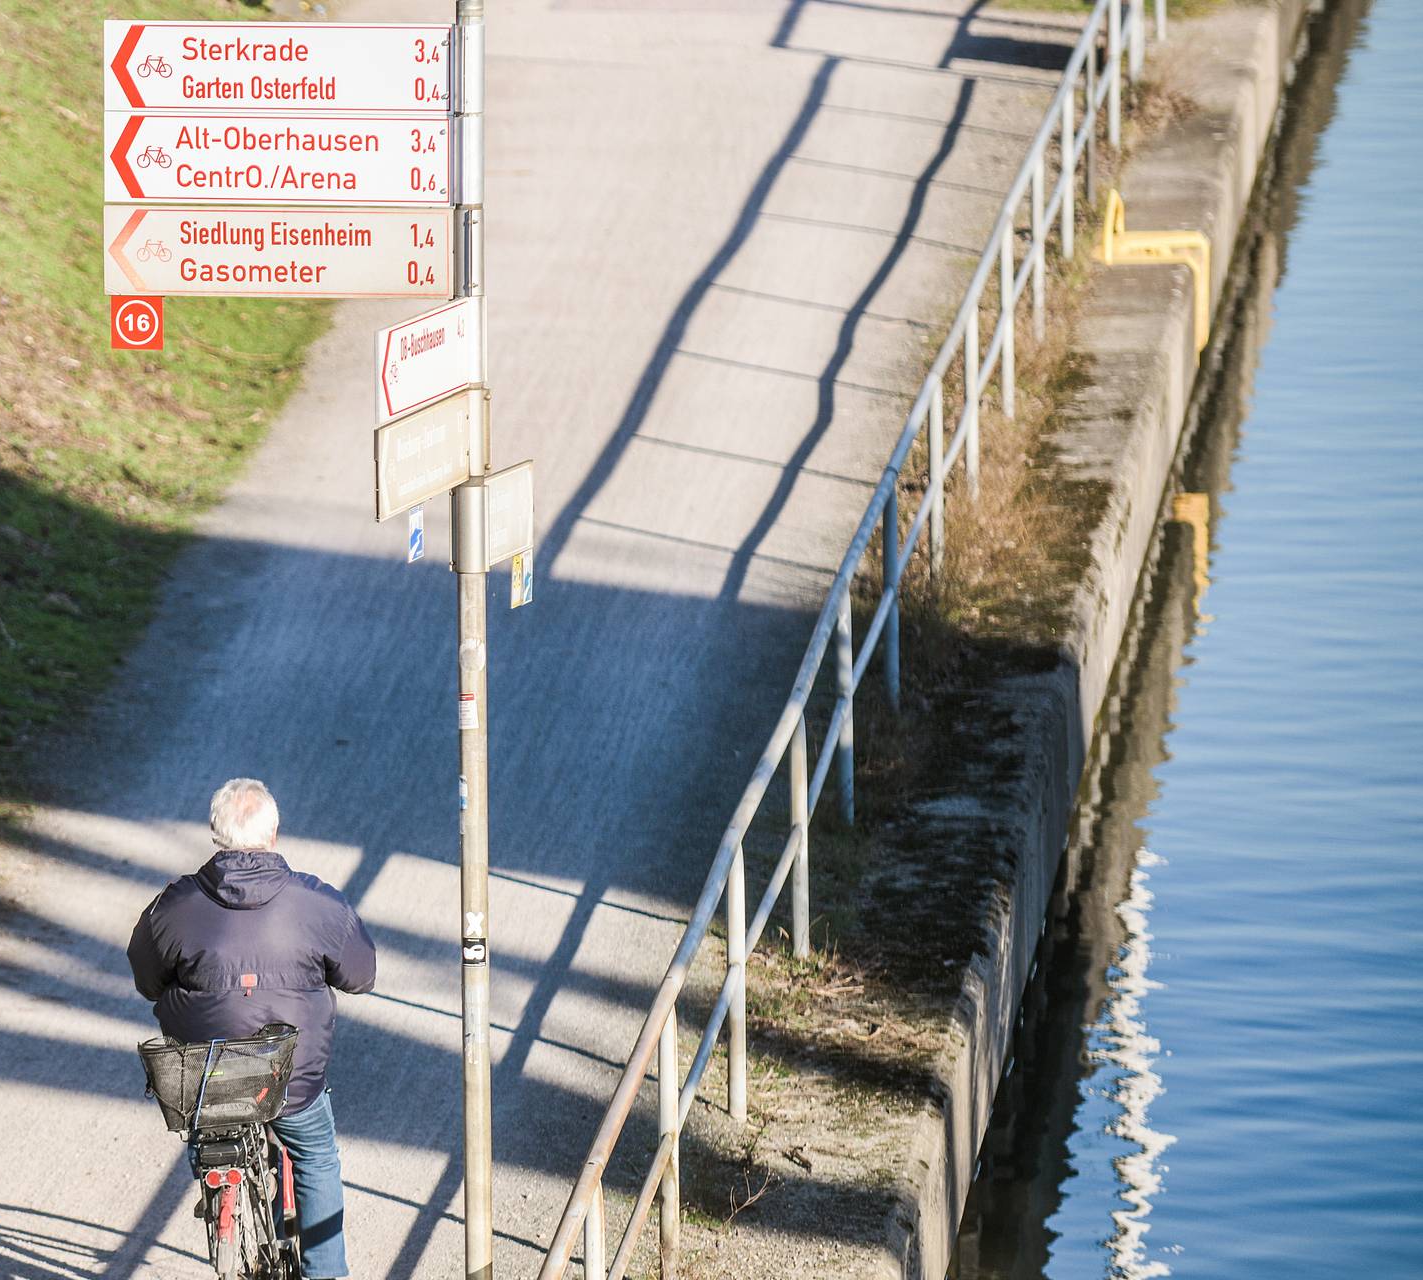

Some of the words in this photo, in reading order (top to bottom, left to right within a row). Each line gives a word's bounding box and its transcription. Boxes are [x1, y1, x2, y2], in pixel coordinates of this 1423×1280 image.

[182, 37, 309, 62] Sterkrade
[414, 38, 440, 64] 3,4
[182, 75, 244, 100] Garten
[250, 76, 336, 101] Osterfeld
[414, 77, 440, 103] 0,4
[176, 126, 379, 152] Alt-Oberhausen
[410, 129, 436, 154] 3,4
[176, 164, 357, 190] CentrO./Arena
[410, 167, 436, 192] 0,6
[179, 221, 265, 252] Siedlung
[270, 222, 372, 248] Eisenheim
[410, 223, 435, 249] 1,4
[180, 258, 327, 284] Gasometer
[407, 260, 435, 286] 0,4
[124, 314, 150, 332] 16
